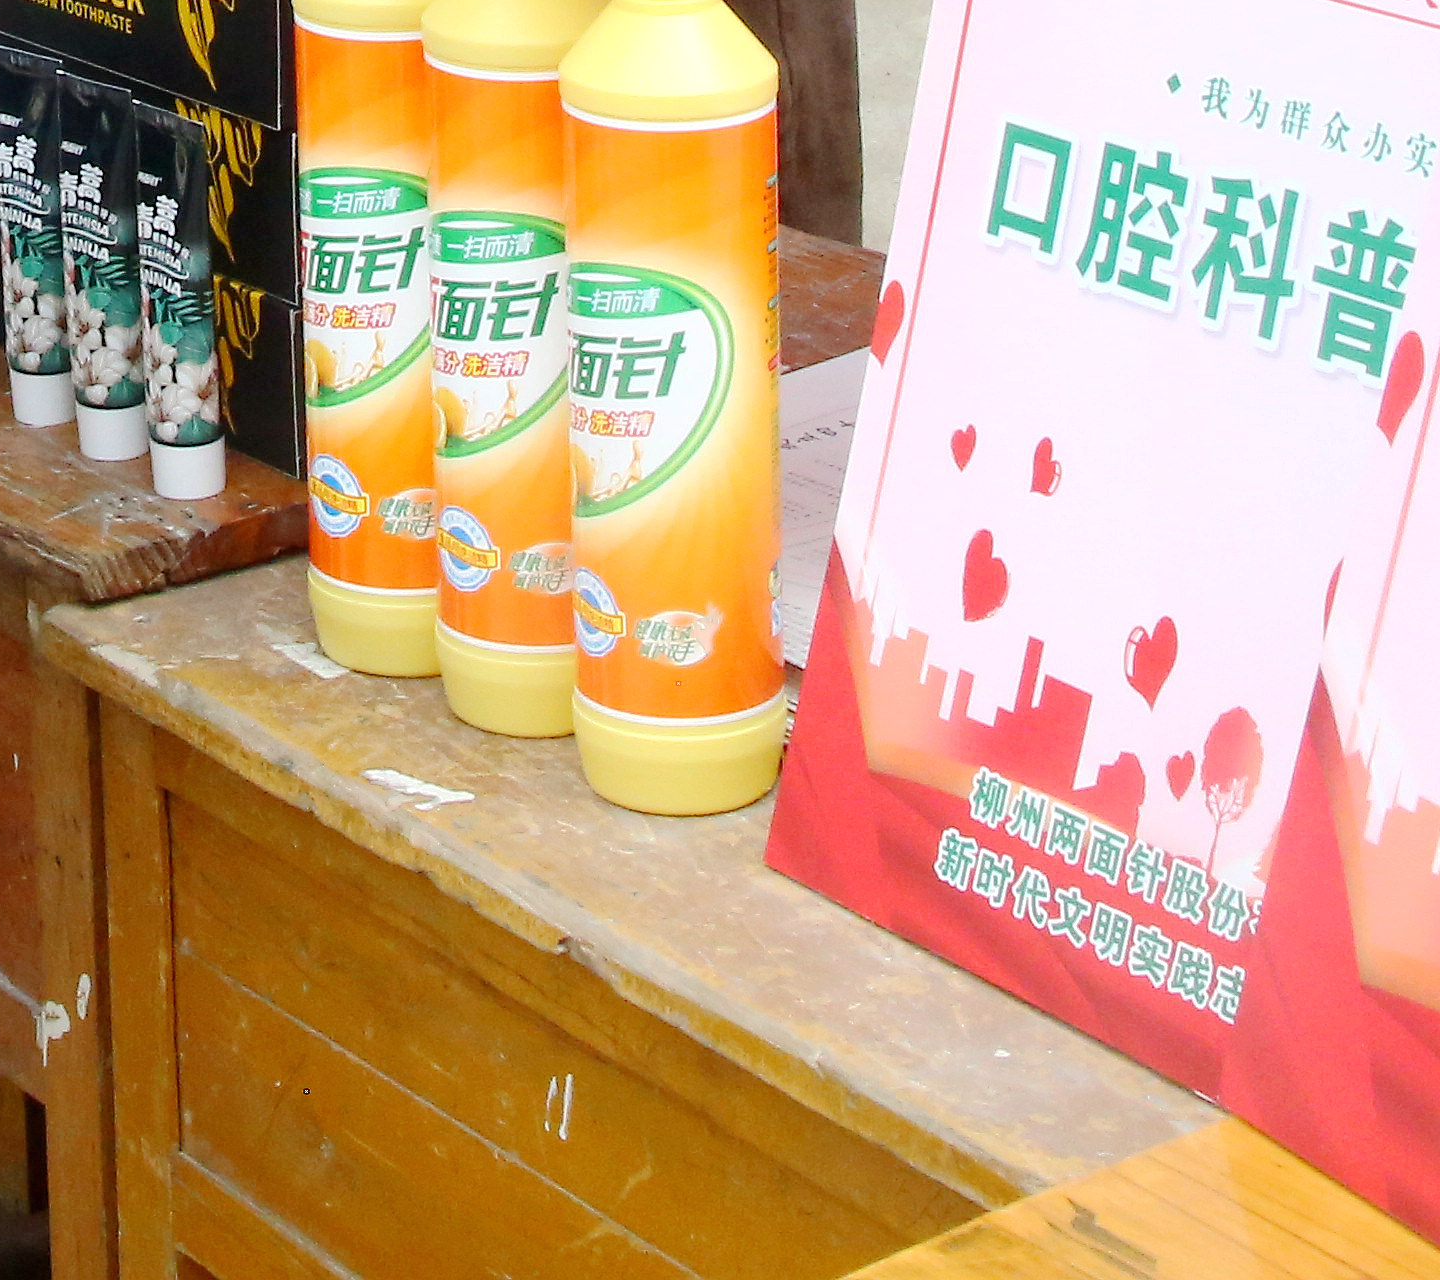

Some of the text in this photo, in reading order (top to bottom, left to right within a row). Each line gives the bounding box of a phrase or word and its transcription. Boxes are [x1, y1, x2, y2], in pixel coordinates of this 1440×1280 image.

[317, 187, 401, 214] 一扫而清
[447, 231, 535, 258] 一扫而清
[986, 120, 1418, 380] 口腔科普
[301, 226, 425, 294] 面针
[431, 271, 560, 341] 面针
[577, 287, 661, 313] 一扫而清
[331, 302, 397, 330] 洗洁精
[461, 351, 530, 378] 洗洁精
[590, 410, 655, 438] 洗洁精
